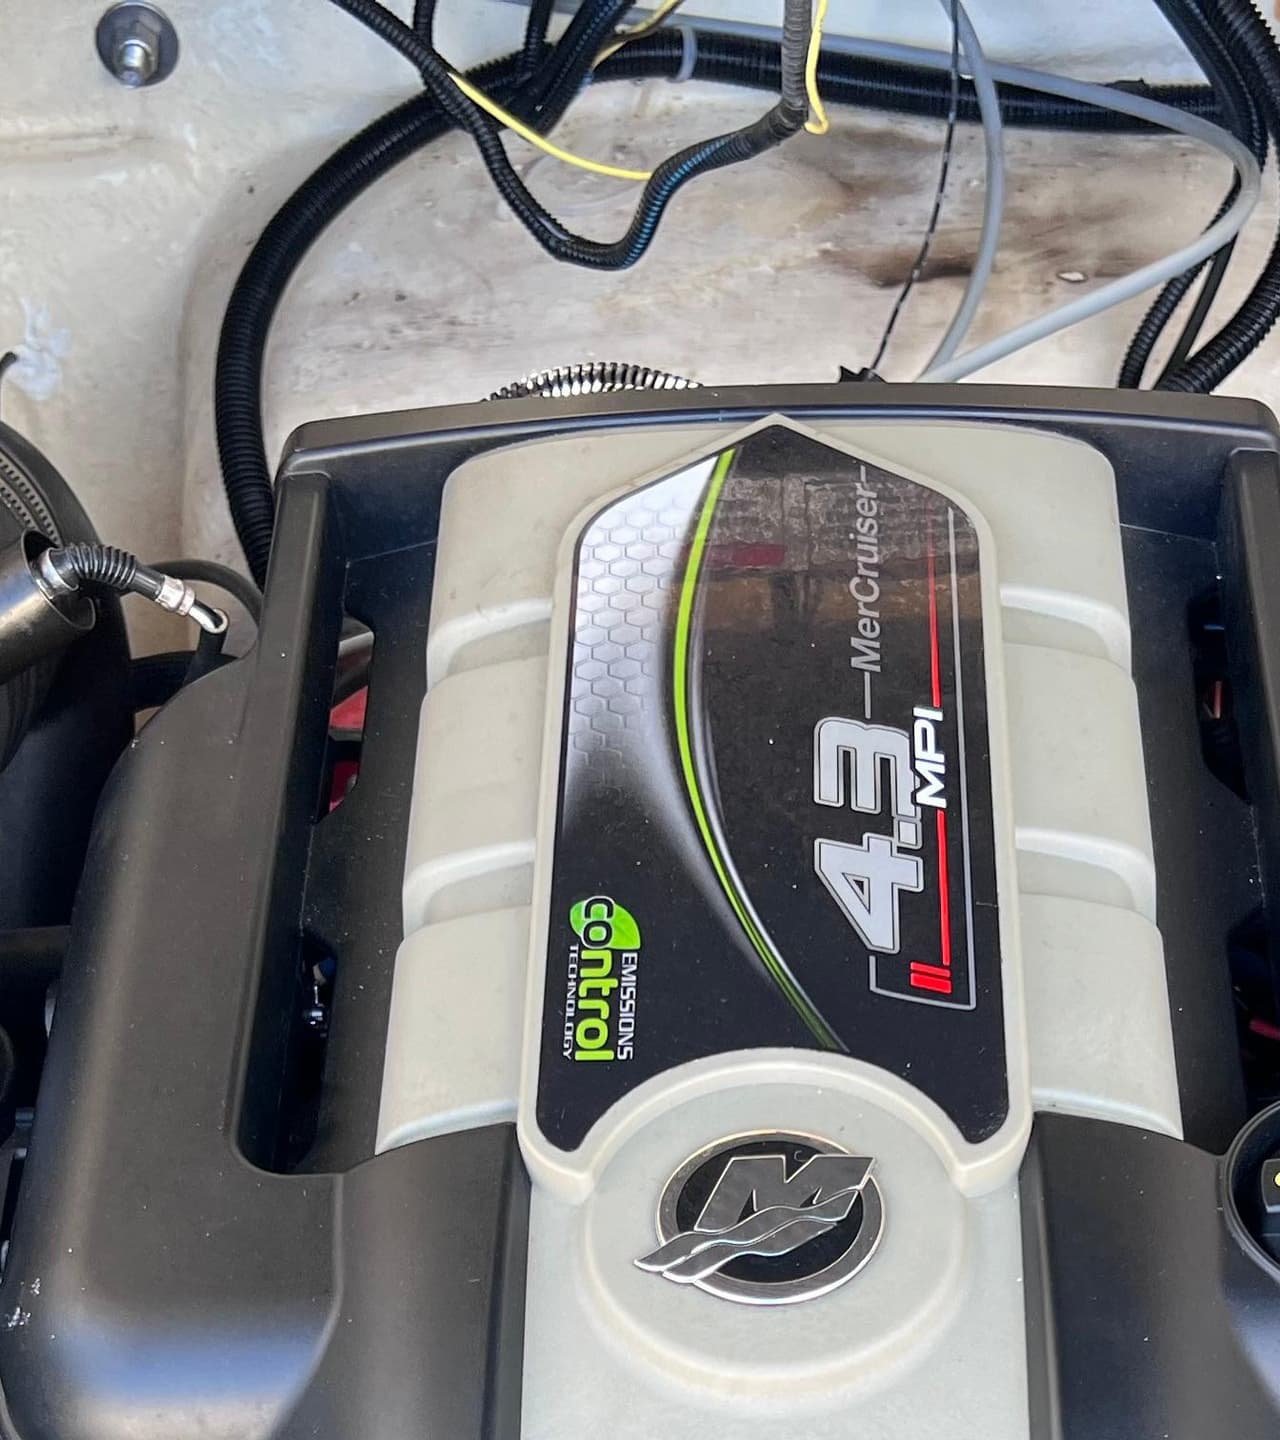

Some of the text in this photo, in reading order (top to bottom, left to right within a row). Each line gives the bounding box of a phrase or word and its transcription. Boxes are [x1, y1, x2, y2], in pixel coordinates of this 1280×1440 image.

[850, 483, 881, 673] MerCruiser
[913, 707, 947, 809] MPI
[814, 716, 924, 955] 4.3
[562, 943, 580, 1060] TECHNOLOGY
[574, 895, 619, 1062] control
[616, 952, 639, 1061] EMISSIONS
